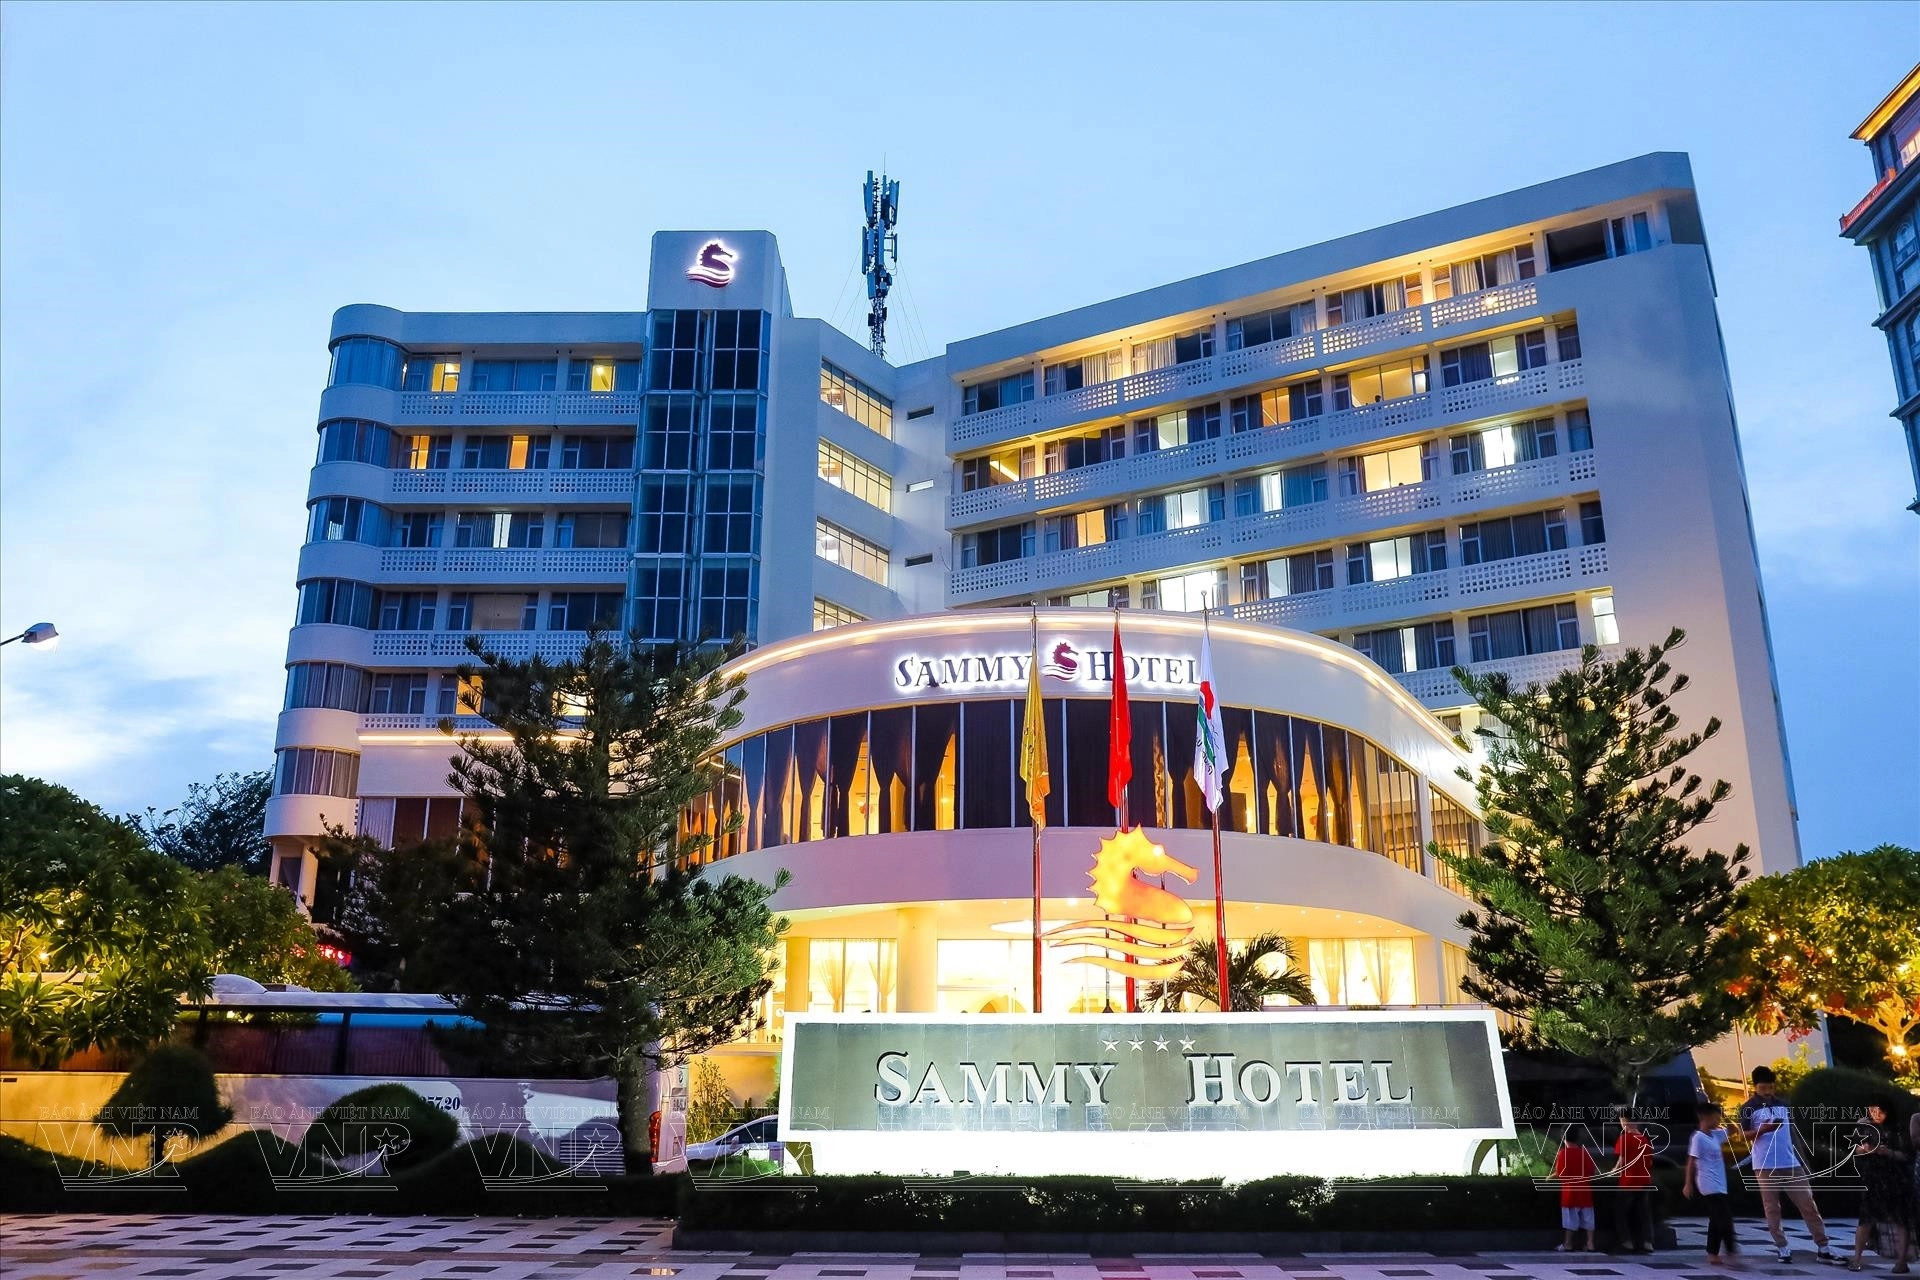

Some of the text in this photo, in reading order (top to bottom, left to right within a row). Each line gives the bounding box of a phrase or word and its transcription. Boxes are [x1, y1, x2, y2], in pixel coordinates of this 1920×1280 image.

[895, 651, 1200, 687] SAMMY HOTEL
[874, 1051, 1412, 1106] SAMMY HOTEL
